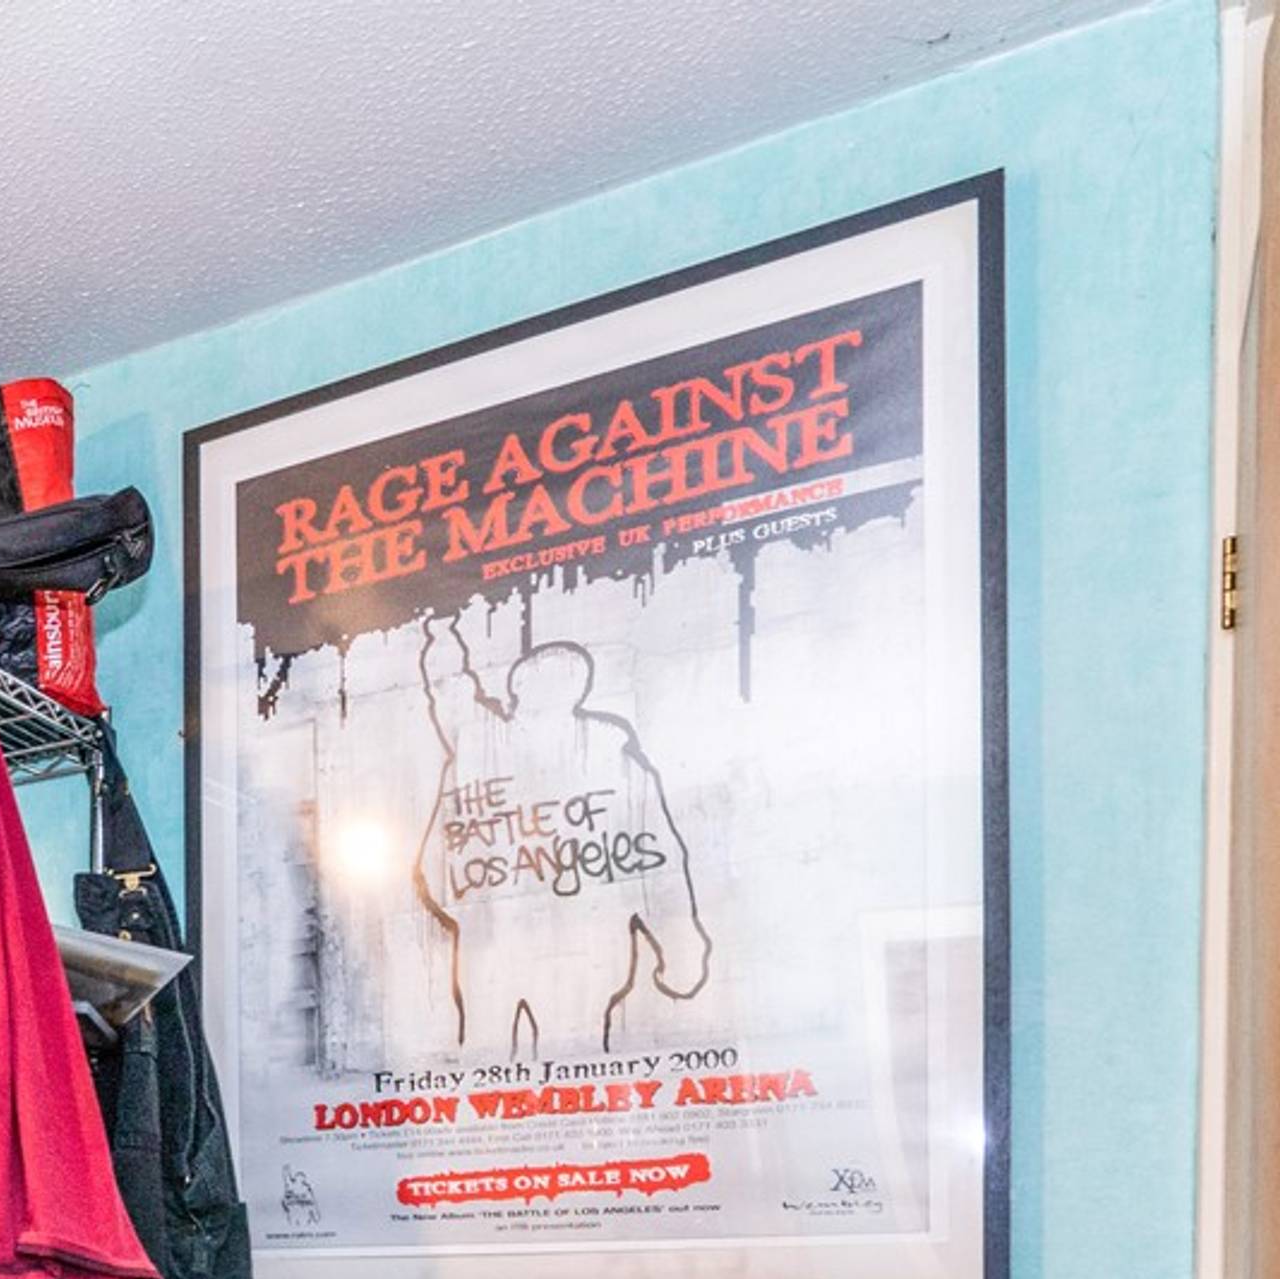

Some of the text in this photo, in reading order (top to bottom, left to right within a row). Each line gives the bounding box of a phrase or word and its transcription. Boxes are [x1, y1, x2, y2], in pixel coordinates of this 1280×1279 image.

[275, 330, 862, 553] RAGE AGAINST
[275, 398, 853, 605] THE MACHINE
[482, 478, 845, 580] EXCLUSIVE UK PERFORMANCE
[693, 507, 838, 554] PLUS GUESTS
[43, 591, 62, 680] ainsbur
[441, 777, 513, 816] THE
[444, 790, 616, 854] BATTLE OF
[450, 856, 508, 899] LOS
[373, 1047, 738, 1093] Friday 28th January 2000
[314, 1068, 818, 1130] LONDON WEMBLEY ARENA
[407, 1164, 690, 1197] TICKETS ON SALE NOW
[507, 1208, 550, 1218] BATTLE
[554, 1208, 569, 1217] OF
[574, 1206, 599, 1216] LOS
